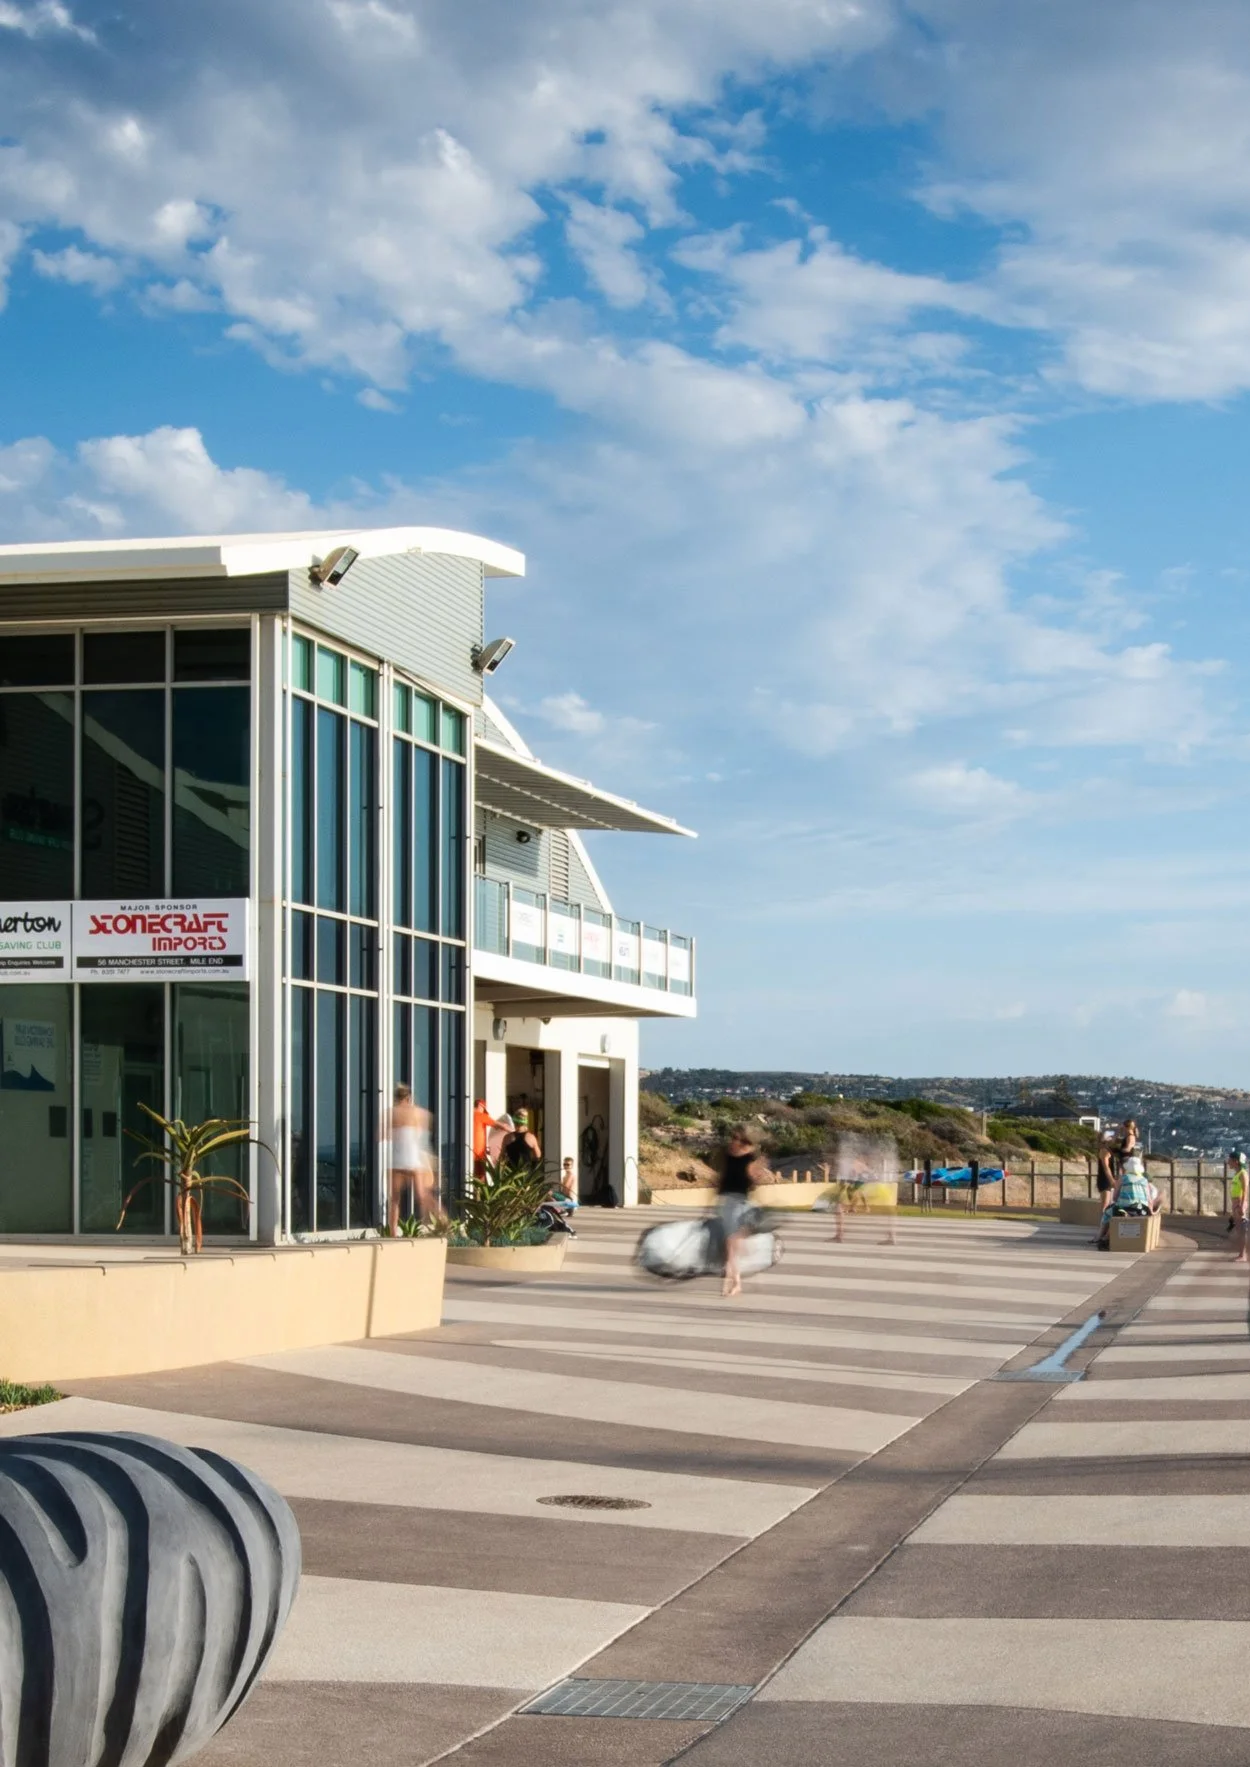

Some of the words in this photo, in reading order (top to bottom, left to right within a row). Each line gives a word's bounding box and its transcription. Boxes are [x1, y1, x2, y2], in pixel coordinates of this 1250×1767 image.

[89, 913, 229, 934] STONECRAFT
[36, 940, 62, 950] CLUB
[152, 936, 226, 951] IMPORTS
[108, 958, 156, 966] MANCHESTER
[190, 957, 206, 965] MILE
[208, 957, 224, 965] END
